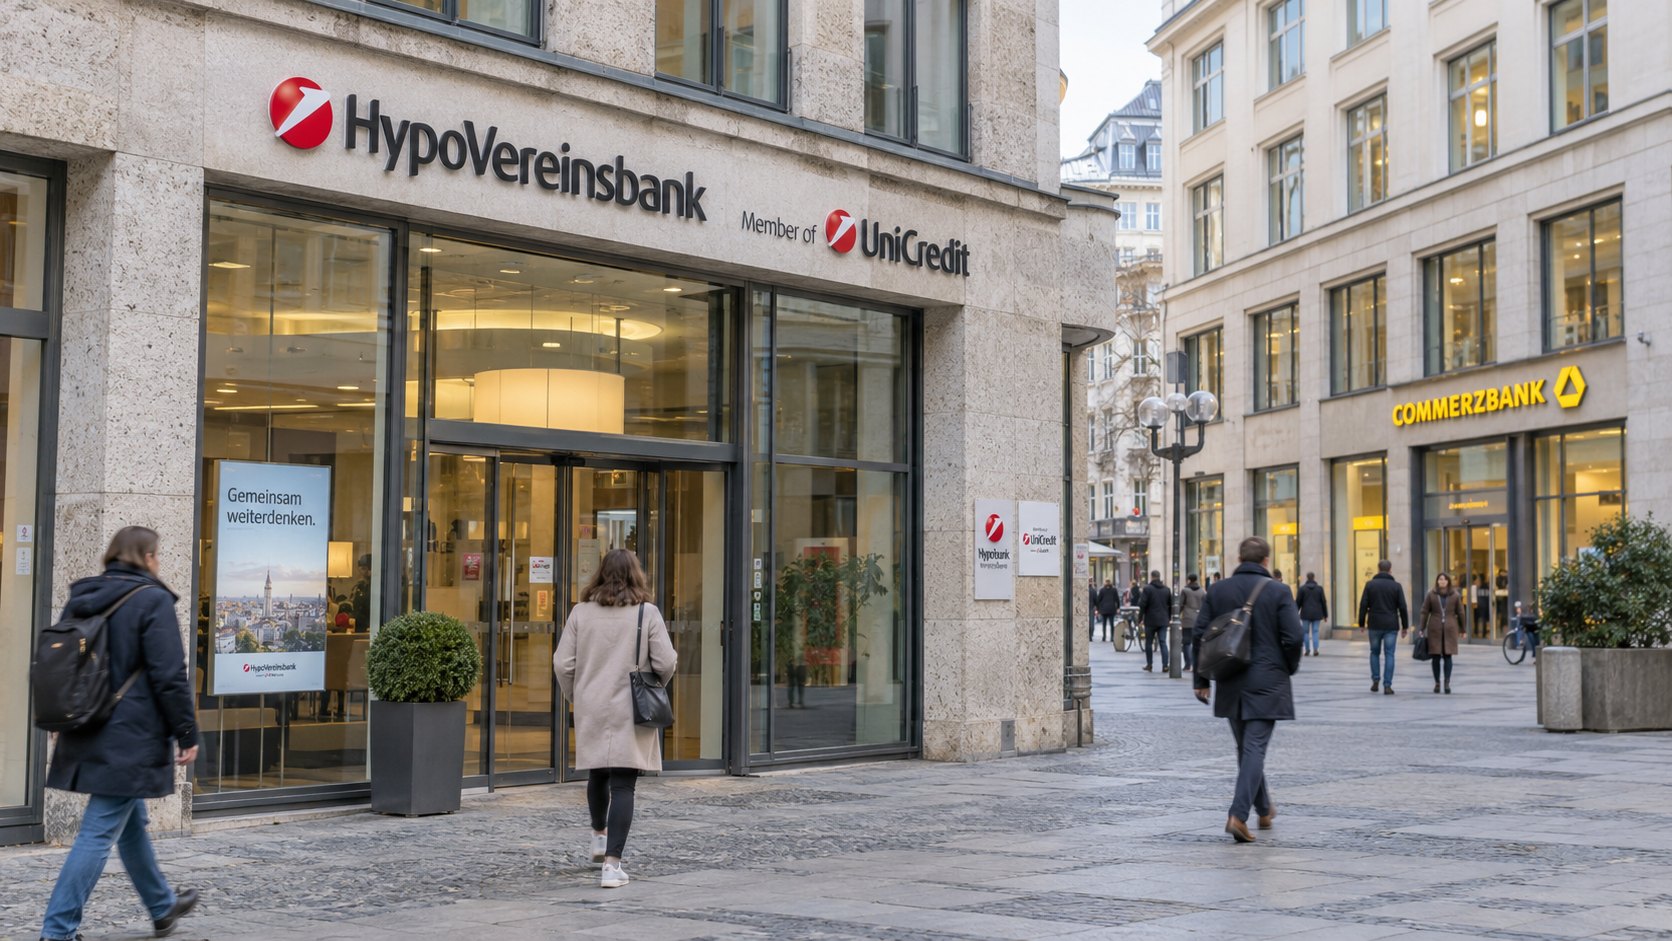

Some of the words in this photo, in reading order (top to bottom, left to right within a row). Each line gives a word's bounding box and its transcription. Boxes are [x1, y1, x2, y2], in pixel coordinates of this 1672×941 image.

[345, 93, 707, 222] HypoVereinsbank
[741, 210, 799, 240] Member
[802, 224, 817, 244] of
[861, 218, 970, 277] UniCredit
[1392, 379, 1546, 427] COMMERZBANK
[226, 509, 316, 527] weiterdenken.
[227, 487, 302, 506] Gemeinsam
